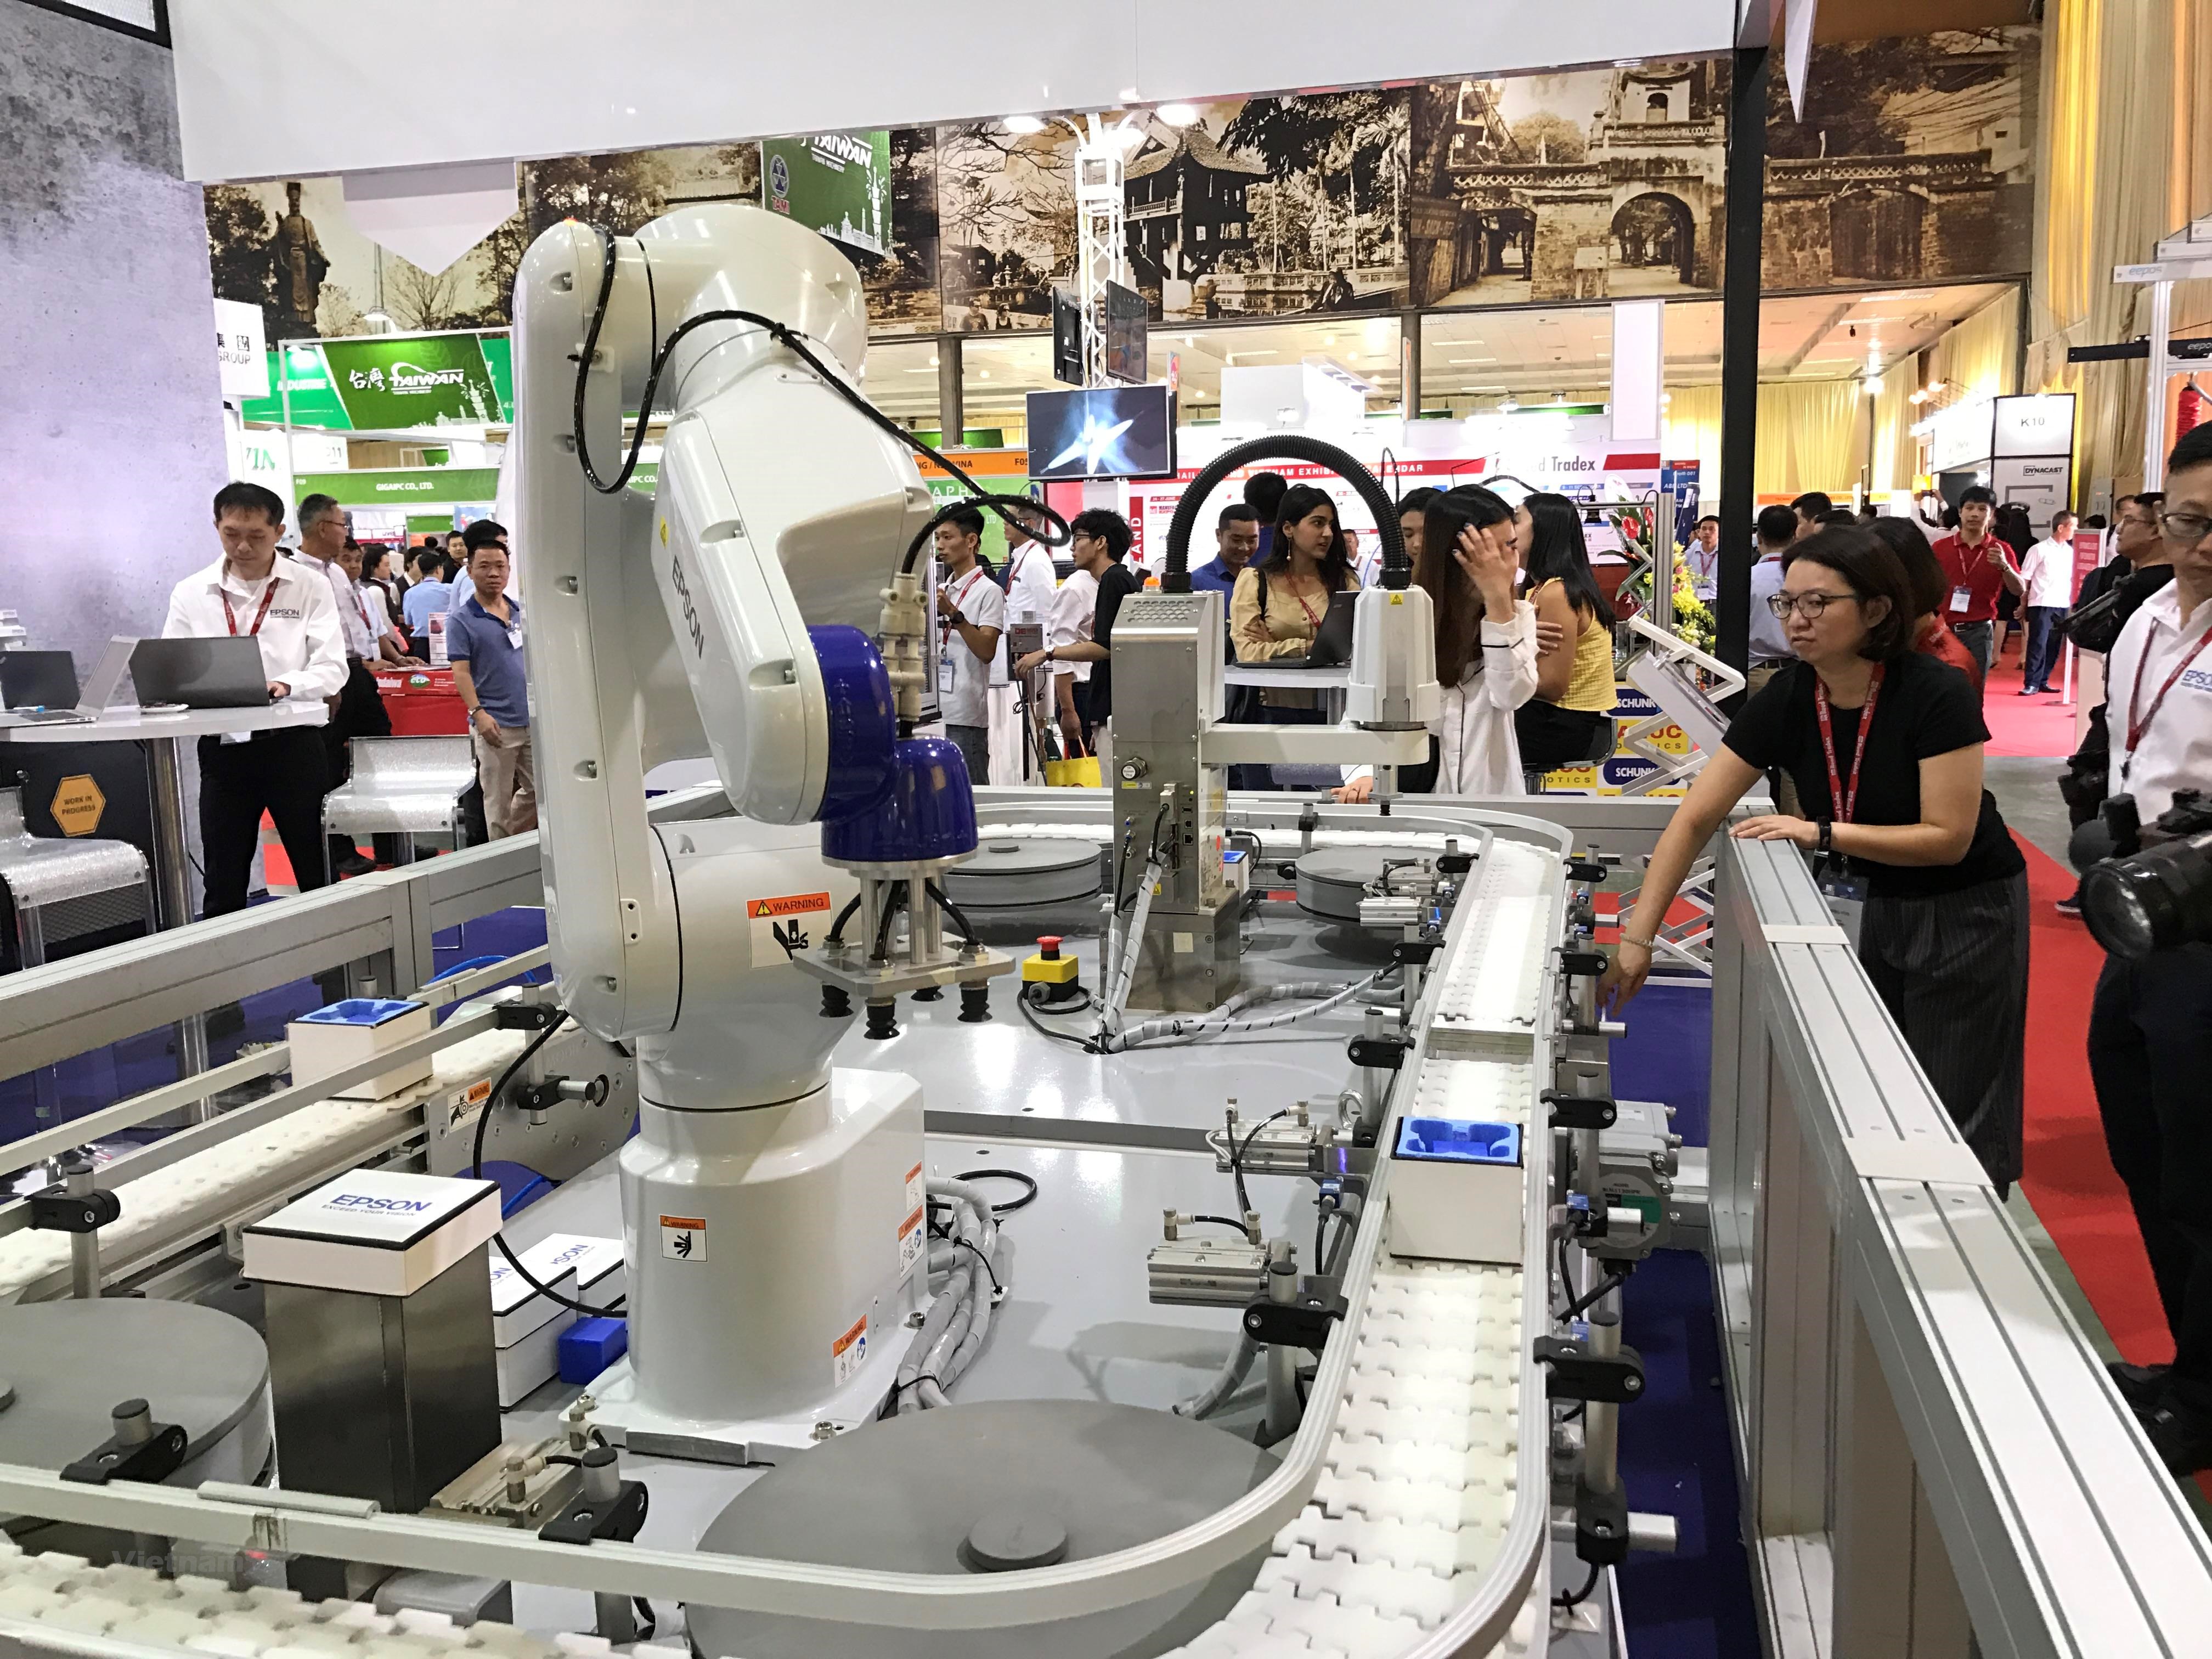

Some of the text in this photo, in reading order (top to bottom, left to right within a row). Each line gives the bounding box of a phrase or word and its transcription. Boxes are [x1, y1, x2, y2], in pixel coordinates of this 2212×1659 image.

[2187, 342, 2212, 351] eepo
[389, 363, 464, 386] TAIWAN
[2021, 417, 2045, 427] K10
[1551, 455, 1596, 471] Tradex
[1299, 467, 1334, 476] EXHIB
[419, 482, 434, 490] LTD.
[672, 554, 704, 659] EPSON
[2182, 669, 2212, 686] EPSO
[1617, 698, 1657, 708] SCHUNK
[1616, 768, 1656, 777] SCHUNK
[64, 796, 83, 805] WORK
[61, 804, 96, 815] PROGRESS
[772, 898, 825, 912] WARNING
[330, 1194, 433, 1211] EPSON
[550, 1244, 589, 1265] SON
